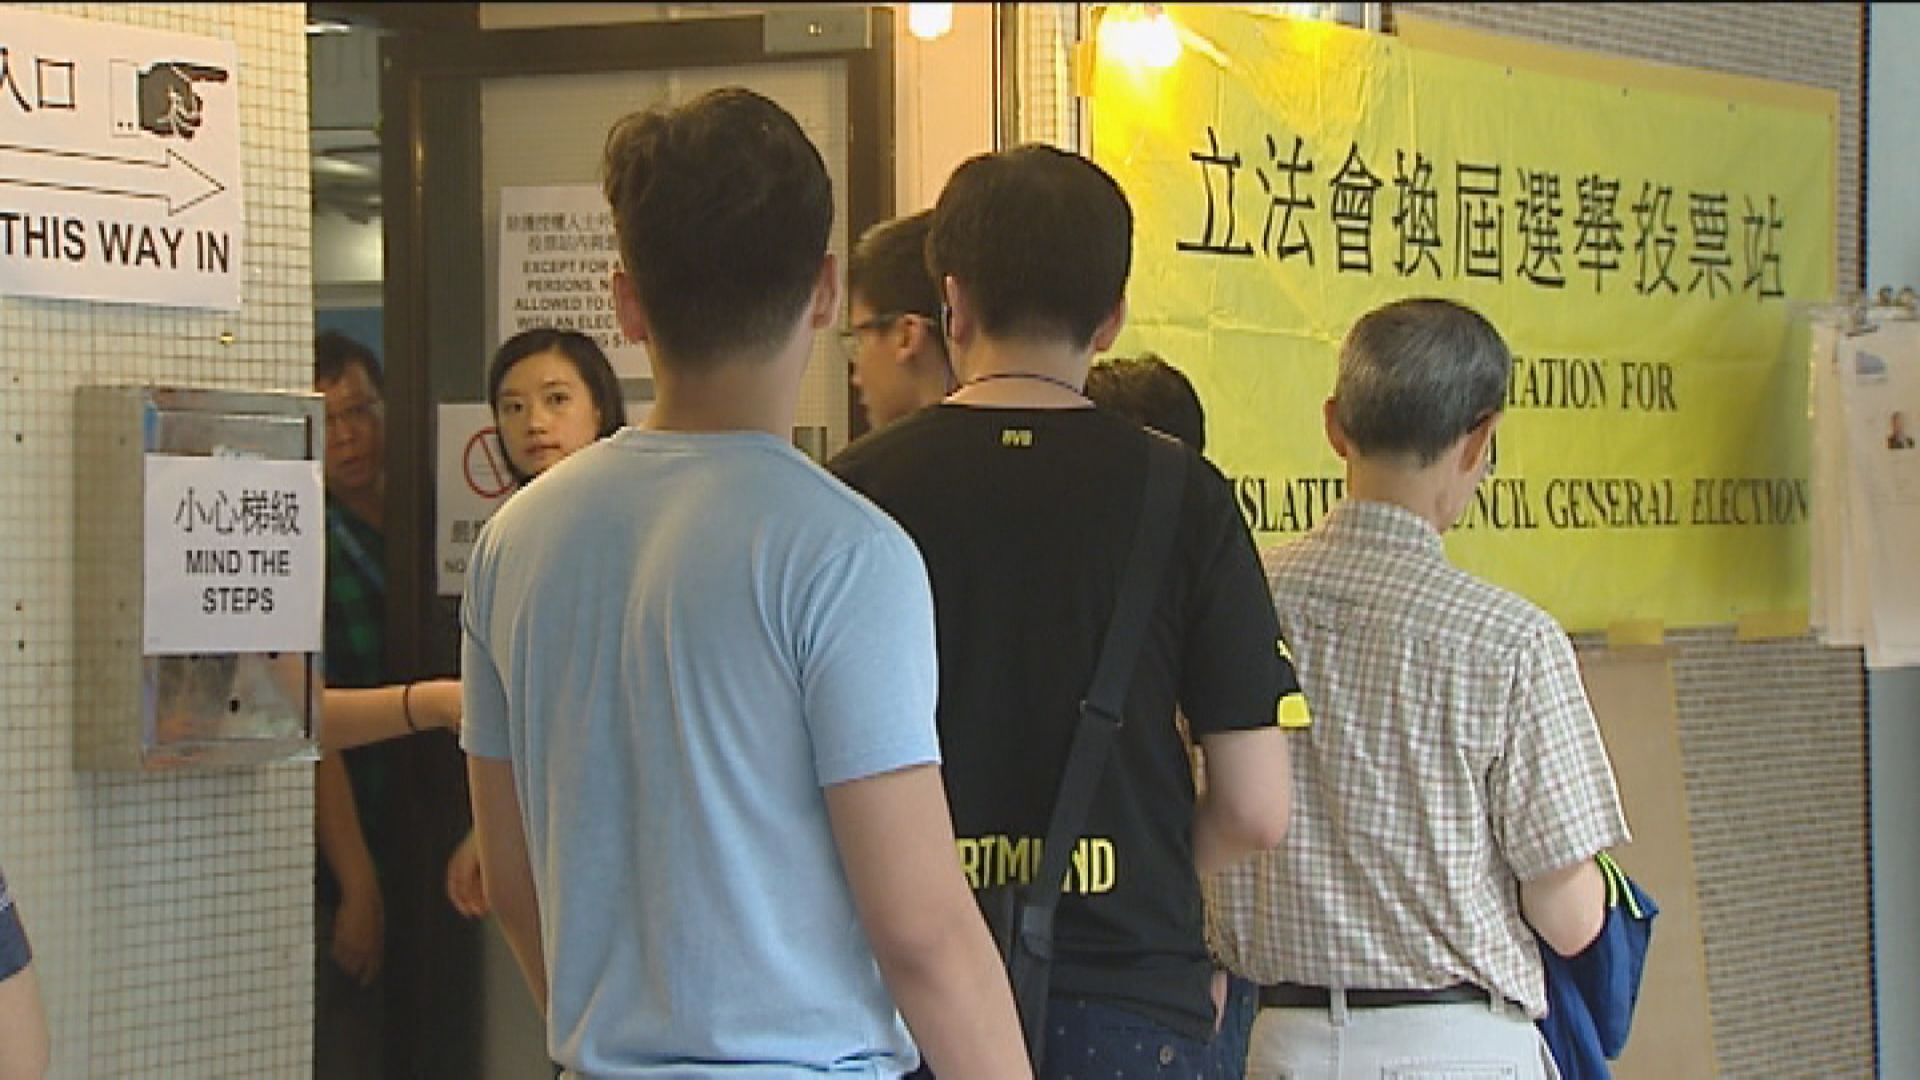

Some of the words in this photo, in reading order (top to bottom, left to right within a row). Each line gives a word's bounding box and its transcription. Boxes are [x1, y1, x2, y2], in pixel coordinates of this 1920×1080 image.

[1176, 127, 1785, 299] 立法會換屆選舉投票站
[0, 212, 86, 262] THIS
[98, 220, 184, 270] WAY
[196, 231, 229, 273] IN
[522, 260, 575, 273] EXCEPT
[580, 260, 608, 273] FOR
[515, 298, 582, 311] ALLOWED
[587, 298, 603, 311] TO
[578, 315, 614, 328] ELEC
[1509, 357, 1608, 409] TATION
[1621, 362, 1677, 412] FOR
[174, 486, 301, 535] 小心梯級
[1545, 478, 1679, 529] GENERAL
[1691, 477, 1810, 527] ELECTION
[186, 549, 240, 576] MIND
[248, 549, 290, 576] THE
[202, 587, 274, 615] STEPS
